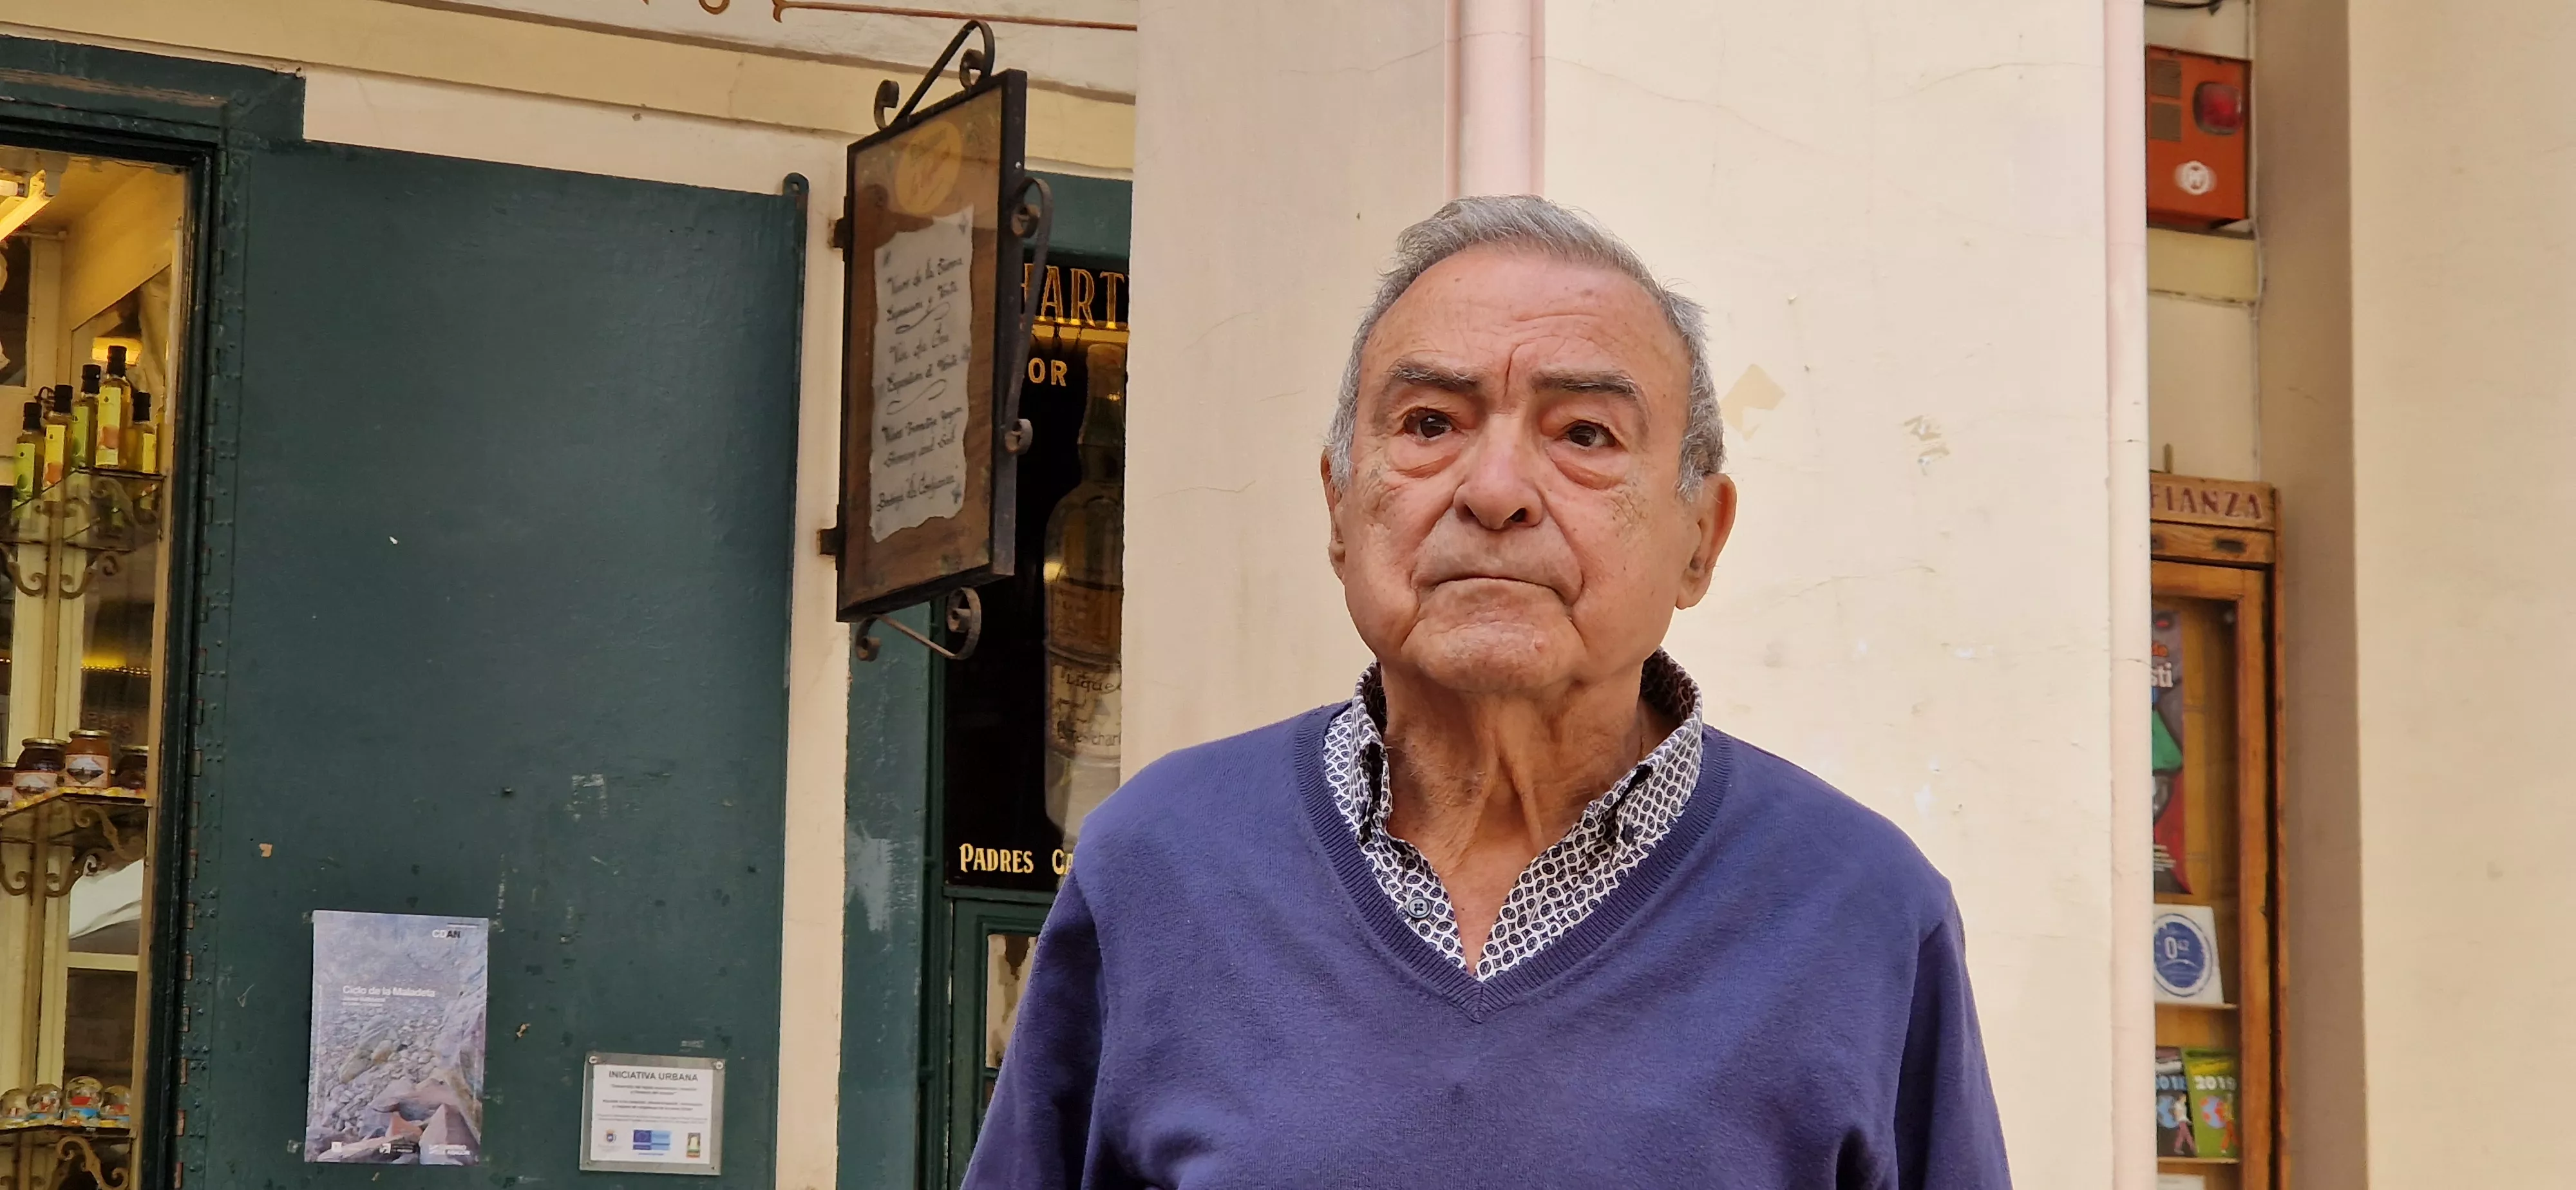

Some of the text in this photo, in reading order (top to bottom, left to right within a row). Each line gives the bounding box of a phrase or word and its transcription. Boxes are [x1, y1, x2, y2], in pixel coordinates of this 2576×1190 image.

[1066, 674, 1121, 694] Lique
[959, 843, 1034, 874] PADRES
[432, 929, 460, 939] CDAN
[343, 985, 436, 997] Ciclo de la Maladeta
[609, 1070, 698, 1082] INICIATIVA URBANA
